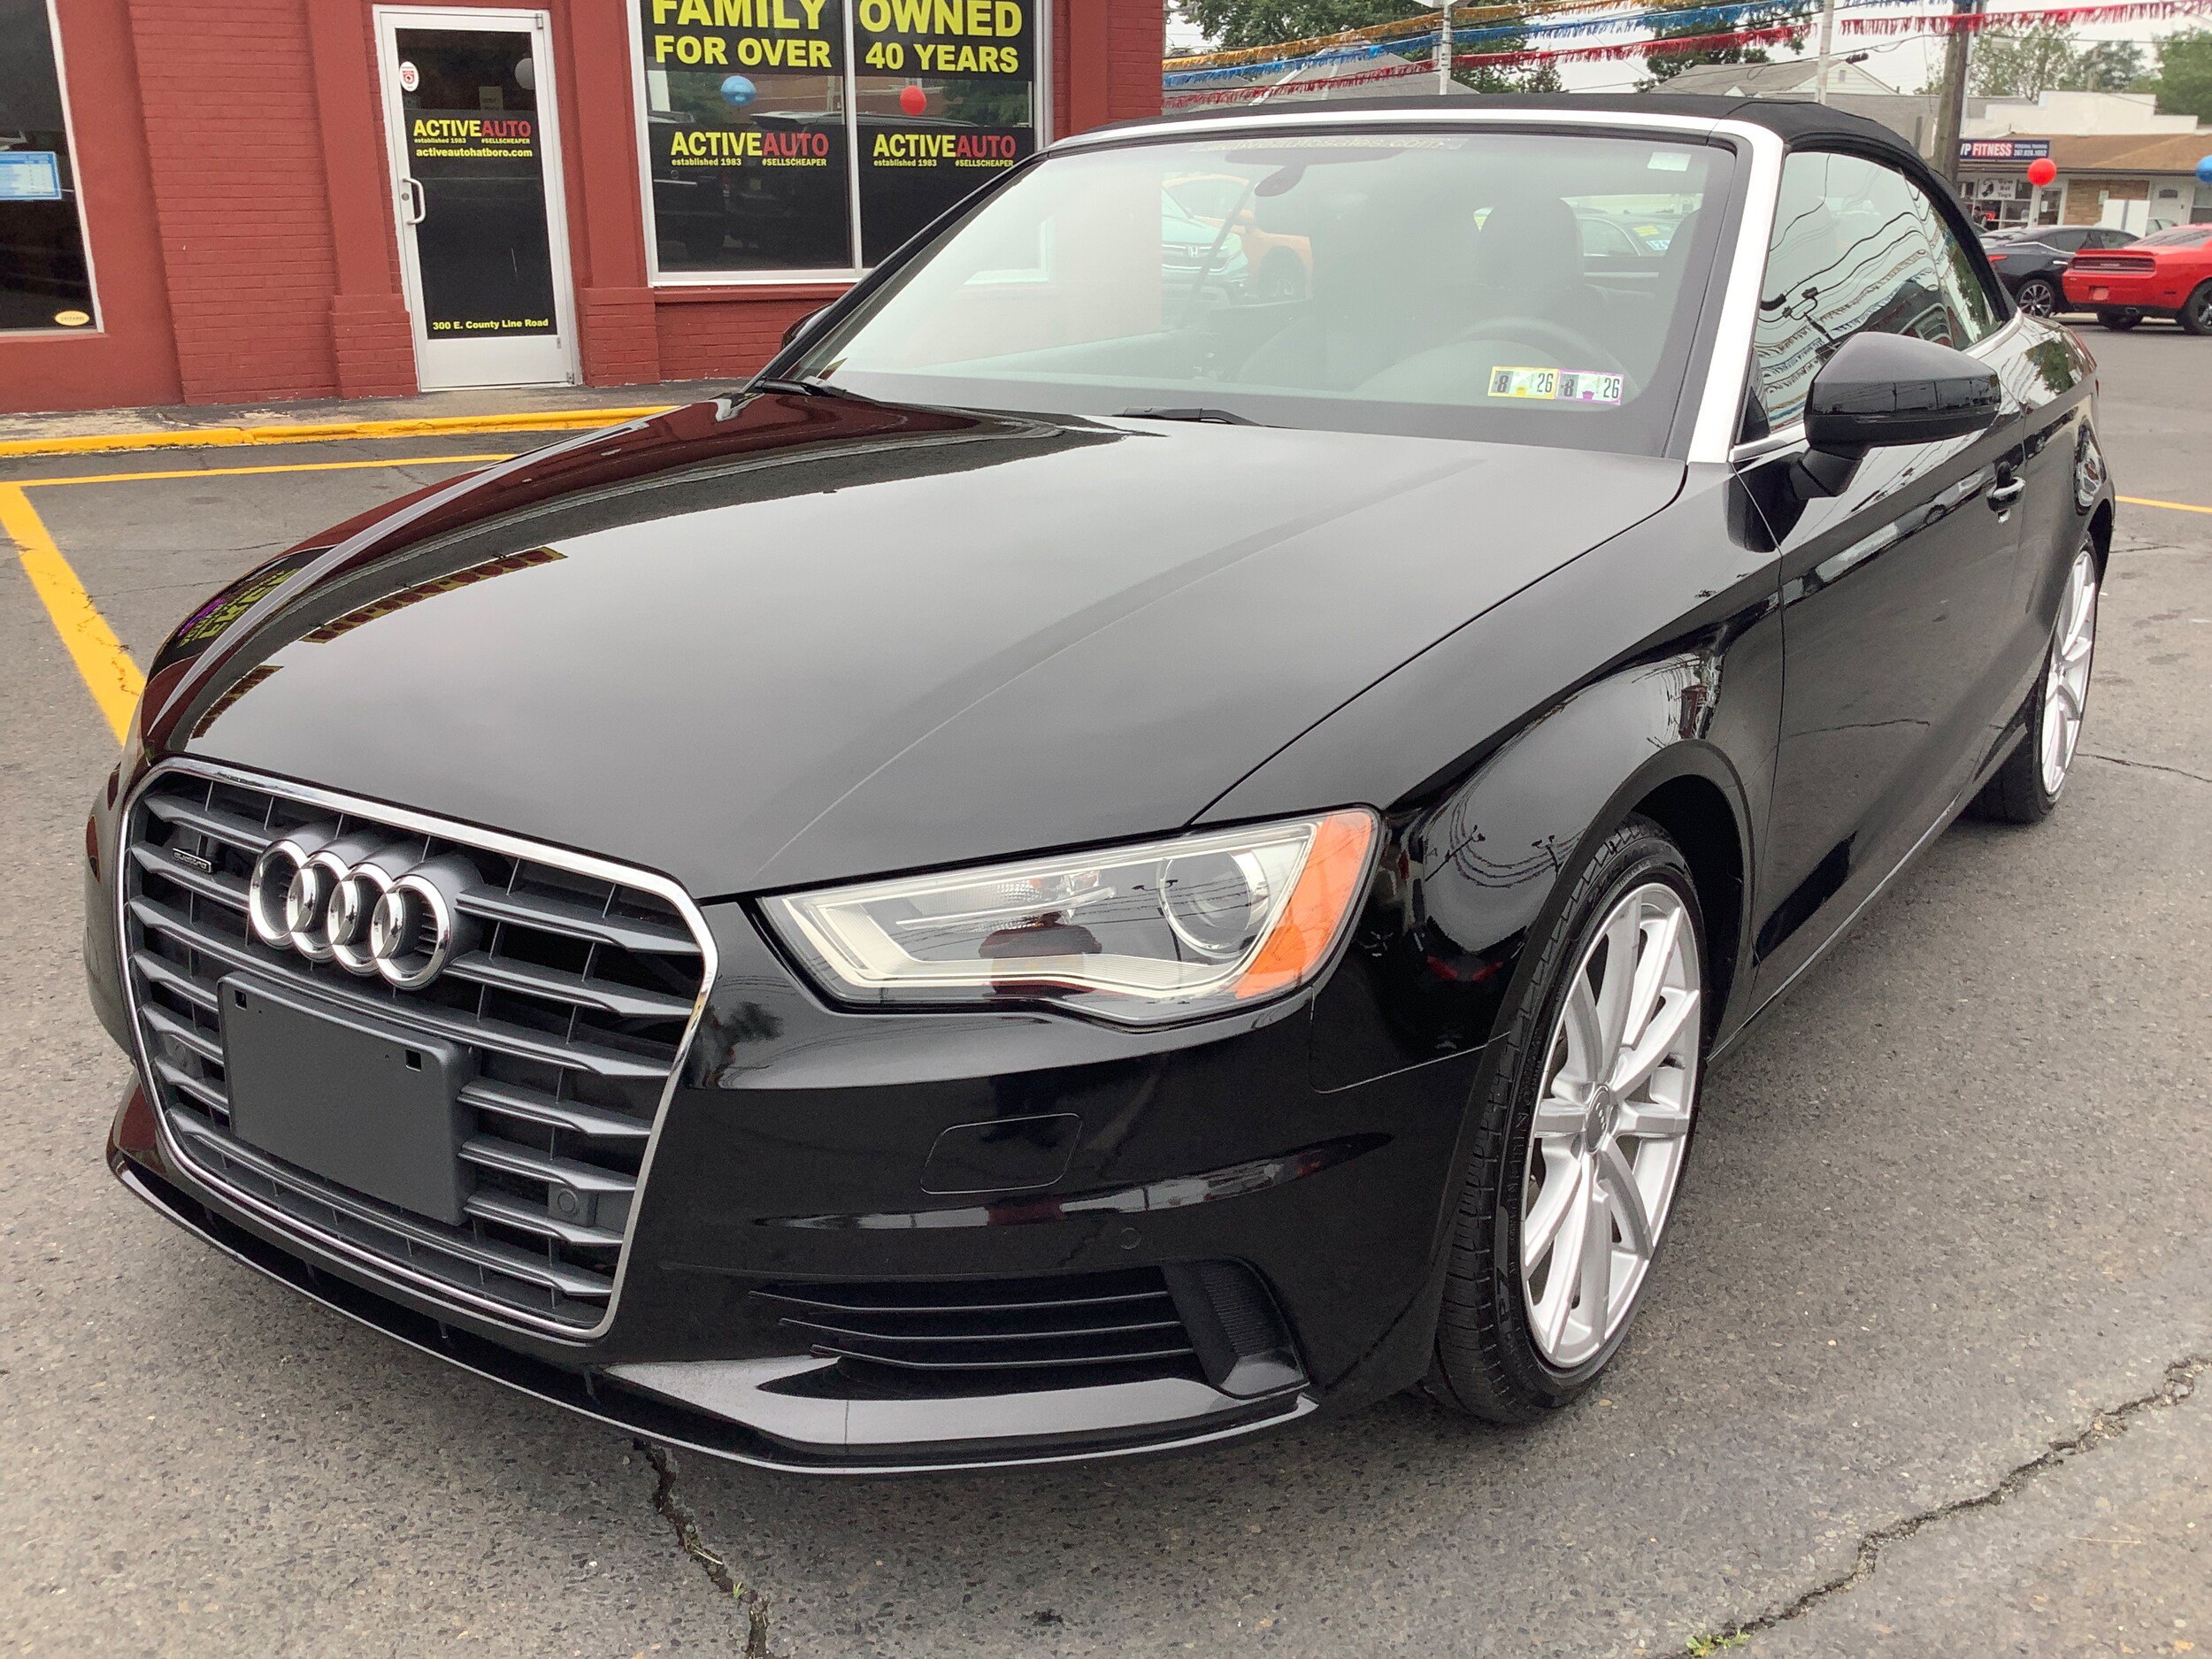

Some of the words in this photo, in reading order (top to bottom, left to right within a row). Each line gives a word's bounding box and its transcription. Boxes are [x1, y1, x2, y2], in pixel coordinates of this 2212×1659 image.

[652, 0, 828, 30] FAMILY
[859, 0, 1023, 37] OWNED
[655, 35, 728, 65] FOR
[737, 37, 832, 68] OVER
[865, 42, 904, 70] 40
[913, 43, 1019, 73] YEARS
[413, 119, 532, 137] ACTIVEAUTO
[416, 147, 533, 157] activeautohatboro.com
[671, 132, 830, 157] ACTIVEAUTO
[872, 134, 1017, 158] ACTIVEAUTO
[1971, 142, 2013, 157] FITNESS
[672, 157, 719, 166] established
[720, 157, 741, 166] 1983
[762, 158, 827, 167] #SELLSCHEAPER
[873, 158, 917, 167] established
[955, 159, 1014, 168] #SELLSCHEAPER
[433, 321, 451, 330] 300
[453, 321, 464, 330] E.
[465, 320, 499, 330] County
[502, 319, 522, 328] Line
[525, 318, 549, 327] Road
[1496, 374, 1509, 394] 8
[1536, 372, 1554, 393] 26
[1563, 378, 1575, 397] 8
[1602, 377, 1620, 399] 26
